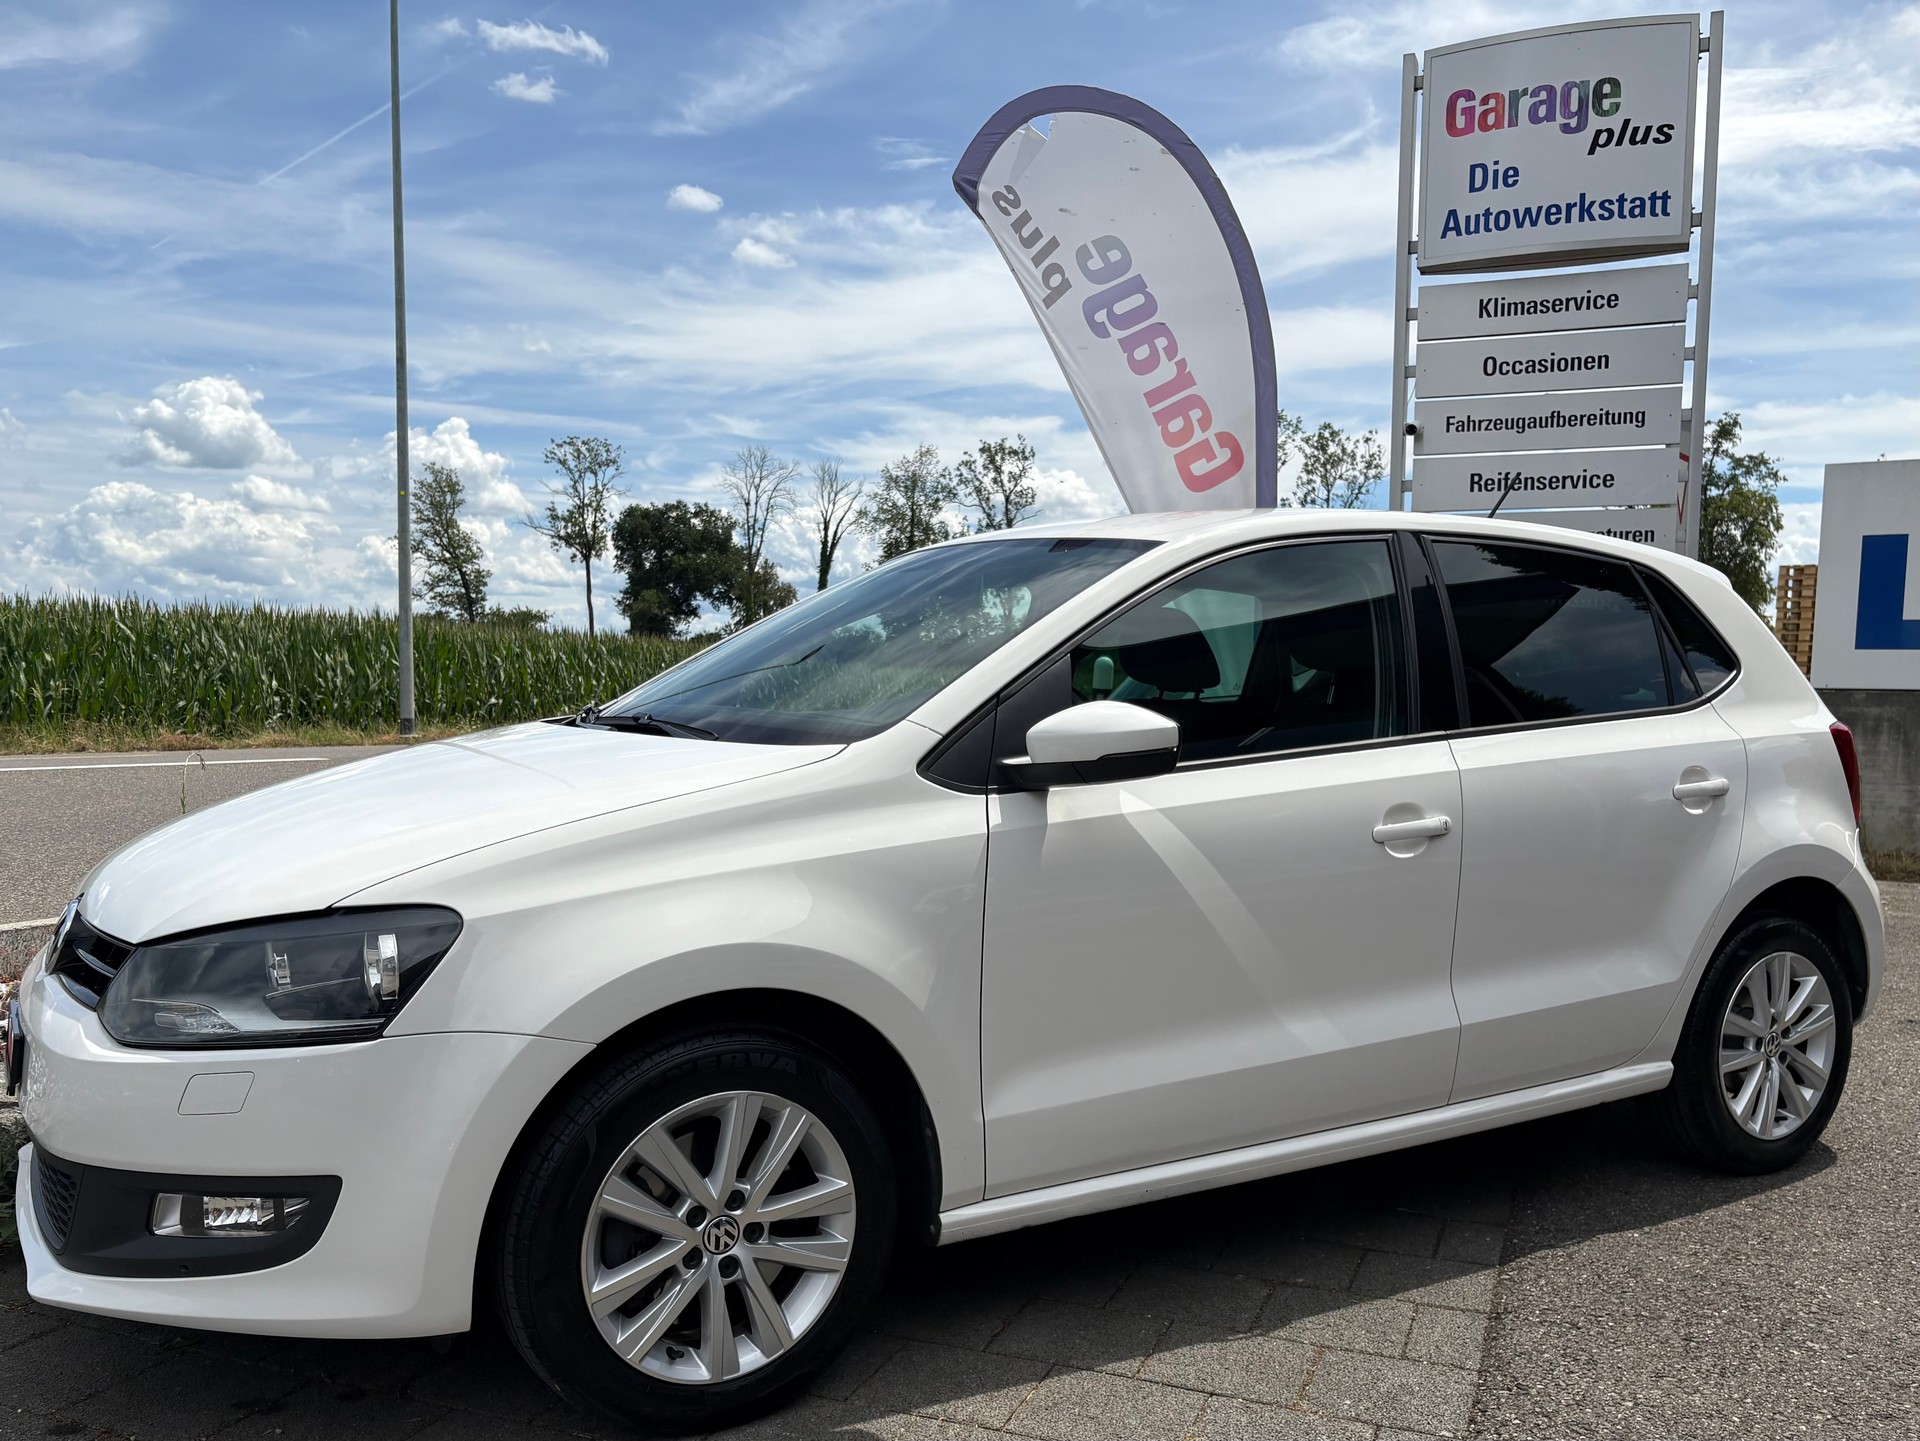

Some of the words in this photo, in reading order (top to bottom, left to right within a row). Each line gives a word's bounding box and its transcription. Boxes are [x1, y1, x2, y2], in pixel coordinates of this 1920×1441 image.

[1445, 76, 1622, 138] Garage
[1587, 118, 1675, 156] plus
[1468, 160, 1520, 194] Die
[1440, 190, 1672, 240] Autowerkstatt
[1478, 289, 1620, 319] Klimaservice
[1482, 352, 1611, 377] Occasionen
[1445, 408, 1647, 434] Fahrzeugaufbereitung
[1469, 469, 1615, 493] Reifenservice
[1589, 528, 1655, 543] turen
